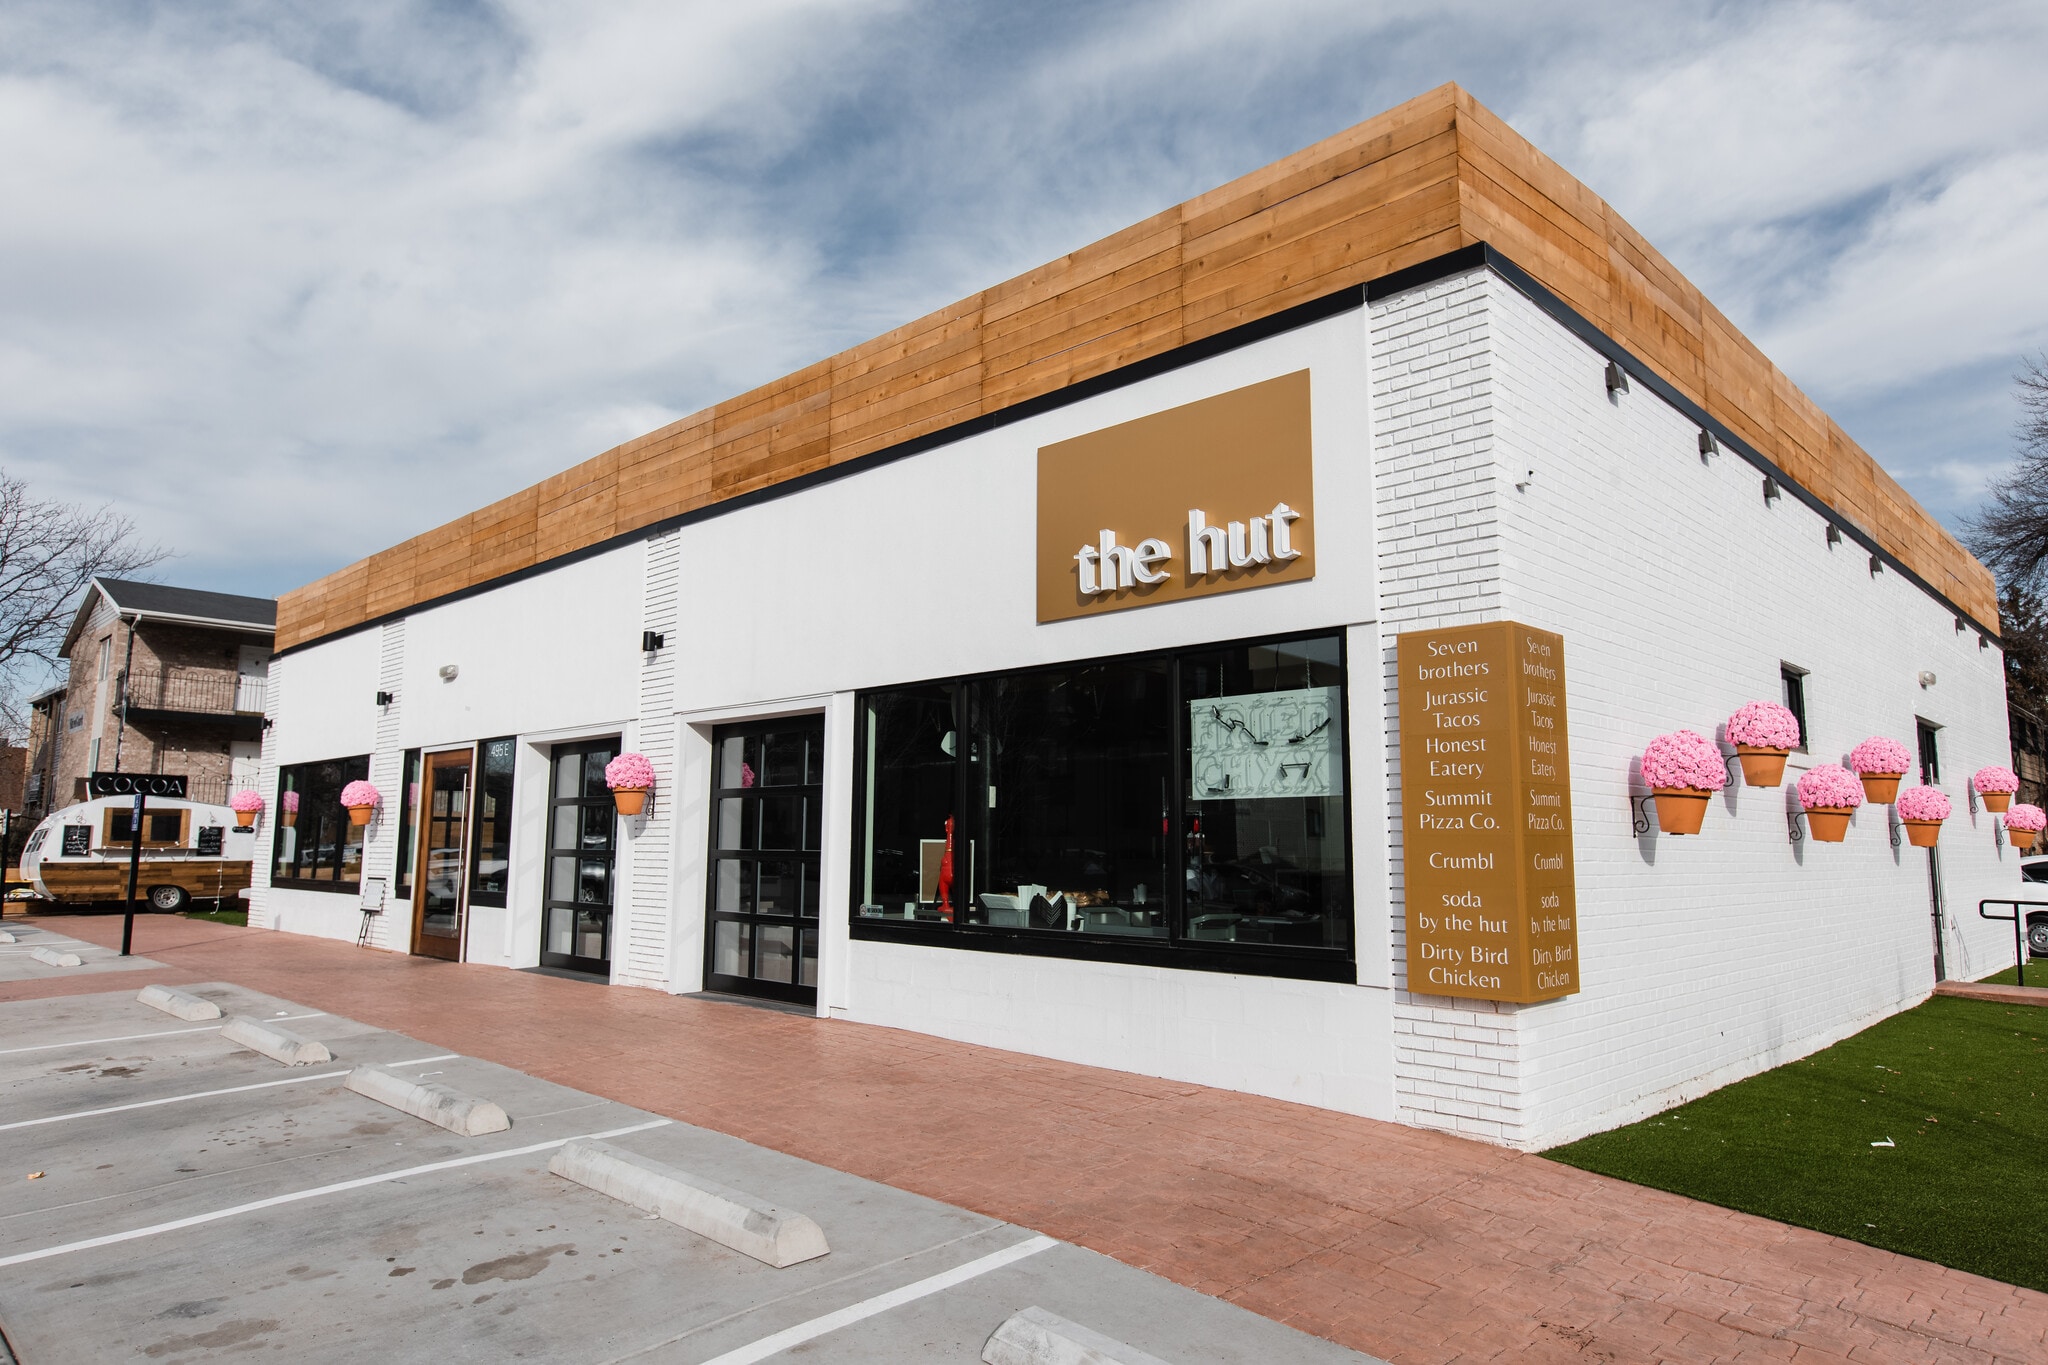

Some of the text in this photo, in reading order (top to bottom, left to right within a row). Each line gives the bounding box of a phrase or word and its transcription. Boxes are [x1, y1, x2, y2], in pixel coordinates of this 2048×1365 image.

[1074, 502, 1301, 595] the hut
[1427, 640, 1478, 657] Seven
[1526, 636, 1551, 657] Seven
[1418, 661, 1489, 681] brothers
[1523, 658, 1556, 681] brothers
[1422, 687, 1488, 711] Jurassic
[1526, 686, 1557, 708] Jurassic
[1432, 712, 1481, 729] Tacos
[1530, 709, 1554, 729] Tacos
[1426, 737, 1487, 754] Honest
[1528, 735, 1557, 755] Honest
[1430, 760, 1485, 780] Eatery
[1531, 758, 1556, 781] Eatery
[96, 776, 183, 794] COCOA
[1425, 789, 1492, 807] Summit
[1529, 789, 1561, 808] Summit
[1419, 812, 1500, 830] Pizza Co.
[1528, 813, 1565, 831] Pizza Co.
[1429, 852, 1494, 870] Crumbl
[1533, 853, 1563, 870] Crumbl
[1441, 890, 1482, 908] soda
[1541, 891, 1560, 909] soda
[1419, 912, 1508, 934] by the hut
[1531, 914, 1571, 938] by the hut
[1421, 942, 1509, 966] Dirty Bird
[1532, 944, 1572, 968] Dirty Bird
[1428, 966, 1501, 989] Chicken
[1537, 971, 1570, 990] Chicken
